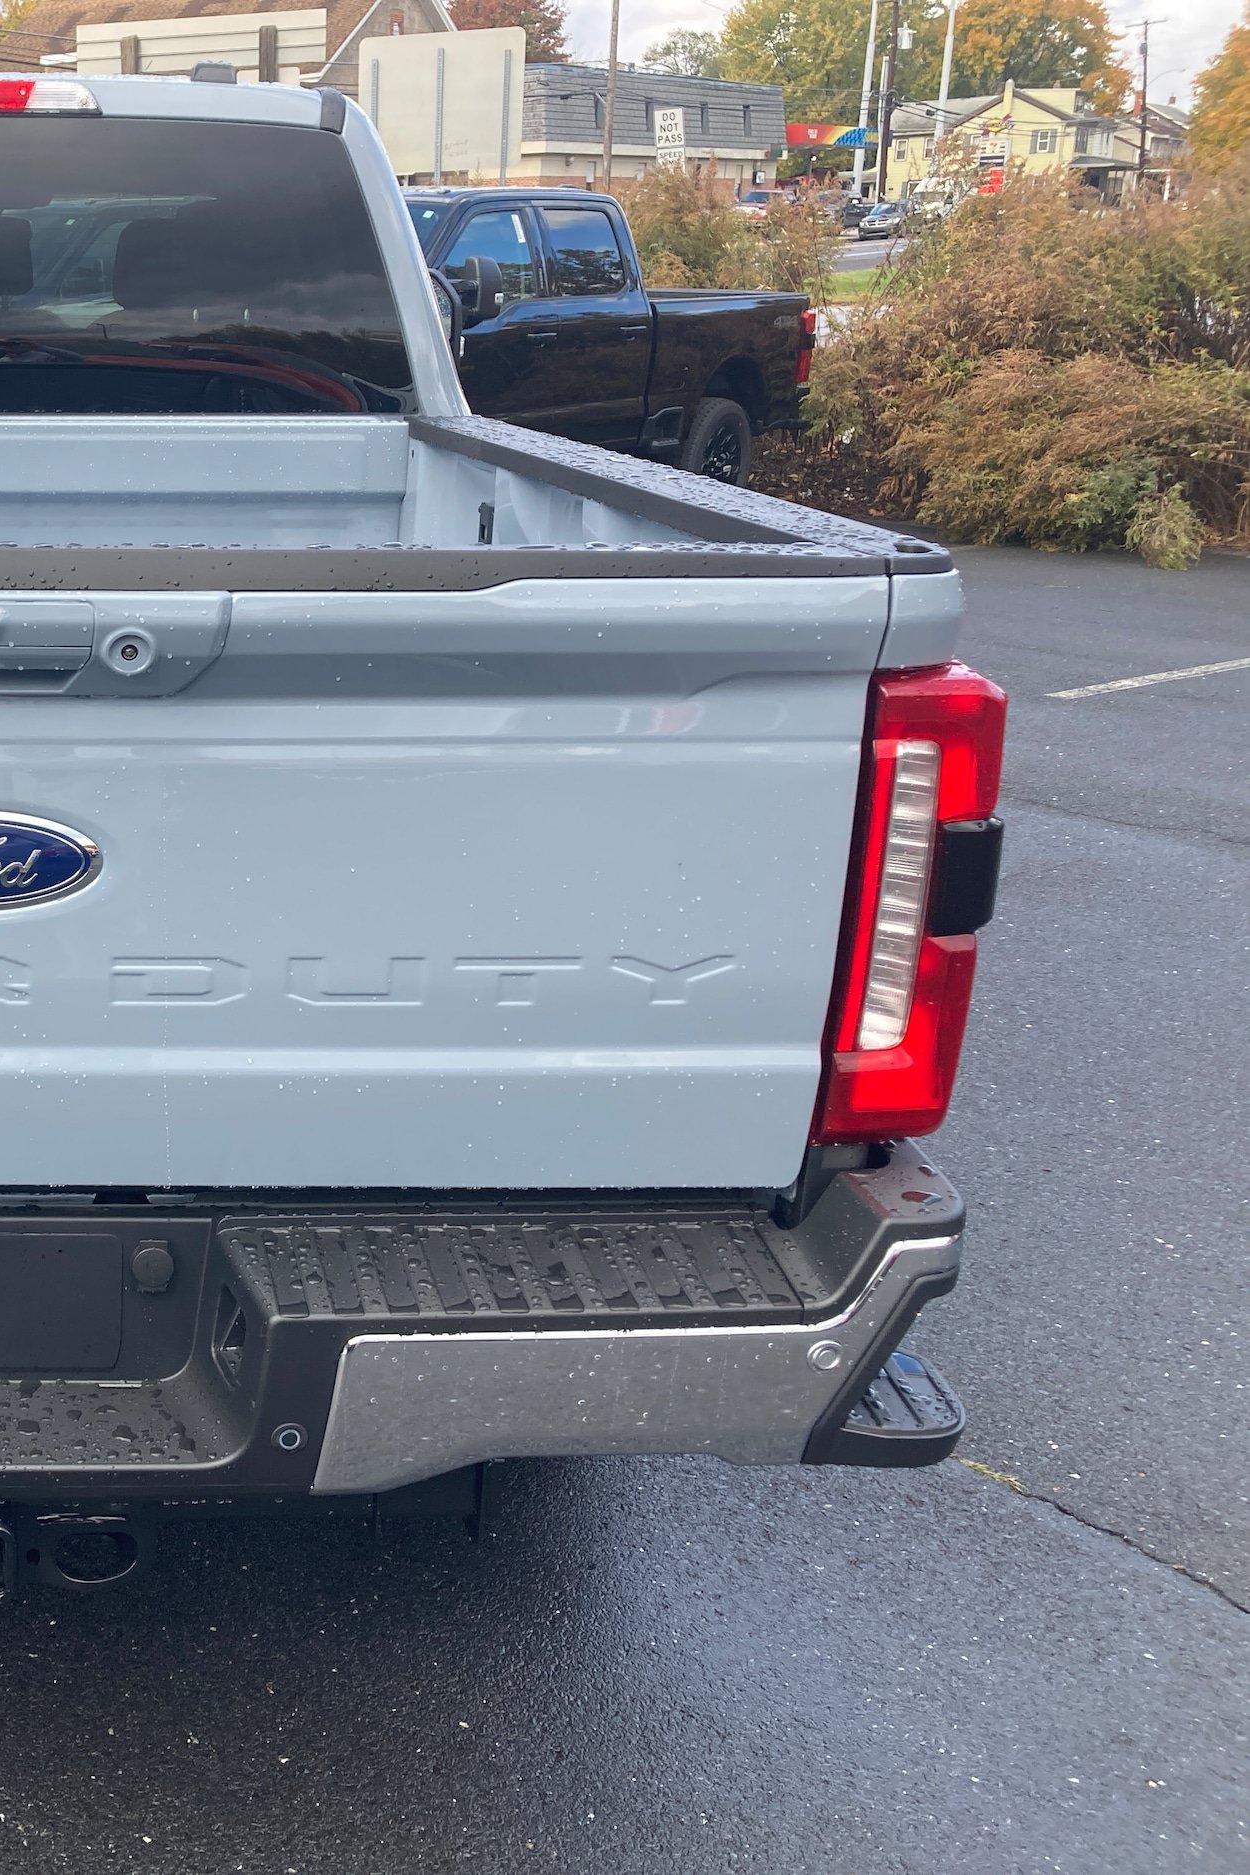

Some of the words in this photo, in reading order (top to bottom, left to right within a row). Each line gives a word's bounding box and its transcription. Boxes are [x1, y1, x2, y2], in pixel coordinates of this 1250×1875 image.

[662, 112, 676, 122] DO
[660, 122, 679, 133] NOT
[658, 134, 683, 144] PASS
[659, 151, 683, 159] SPEED
[110, 954, 738, 1007] DUTY
